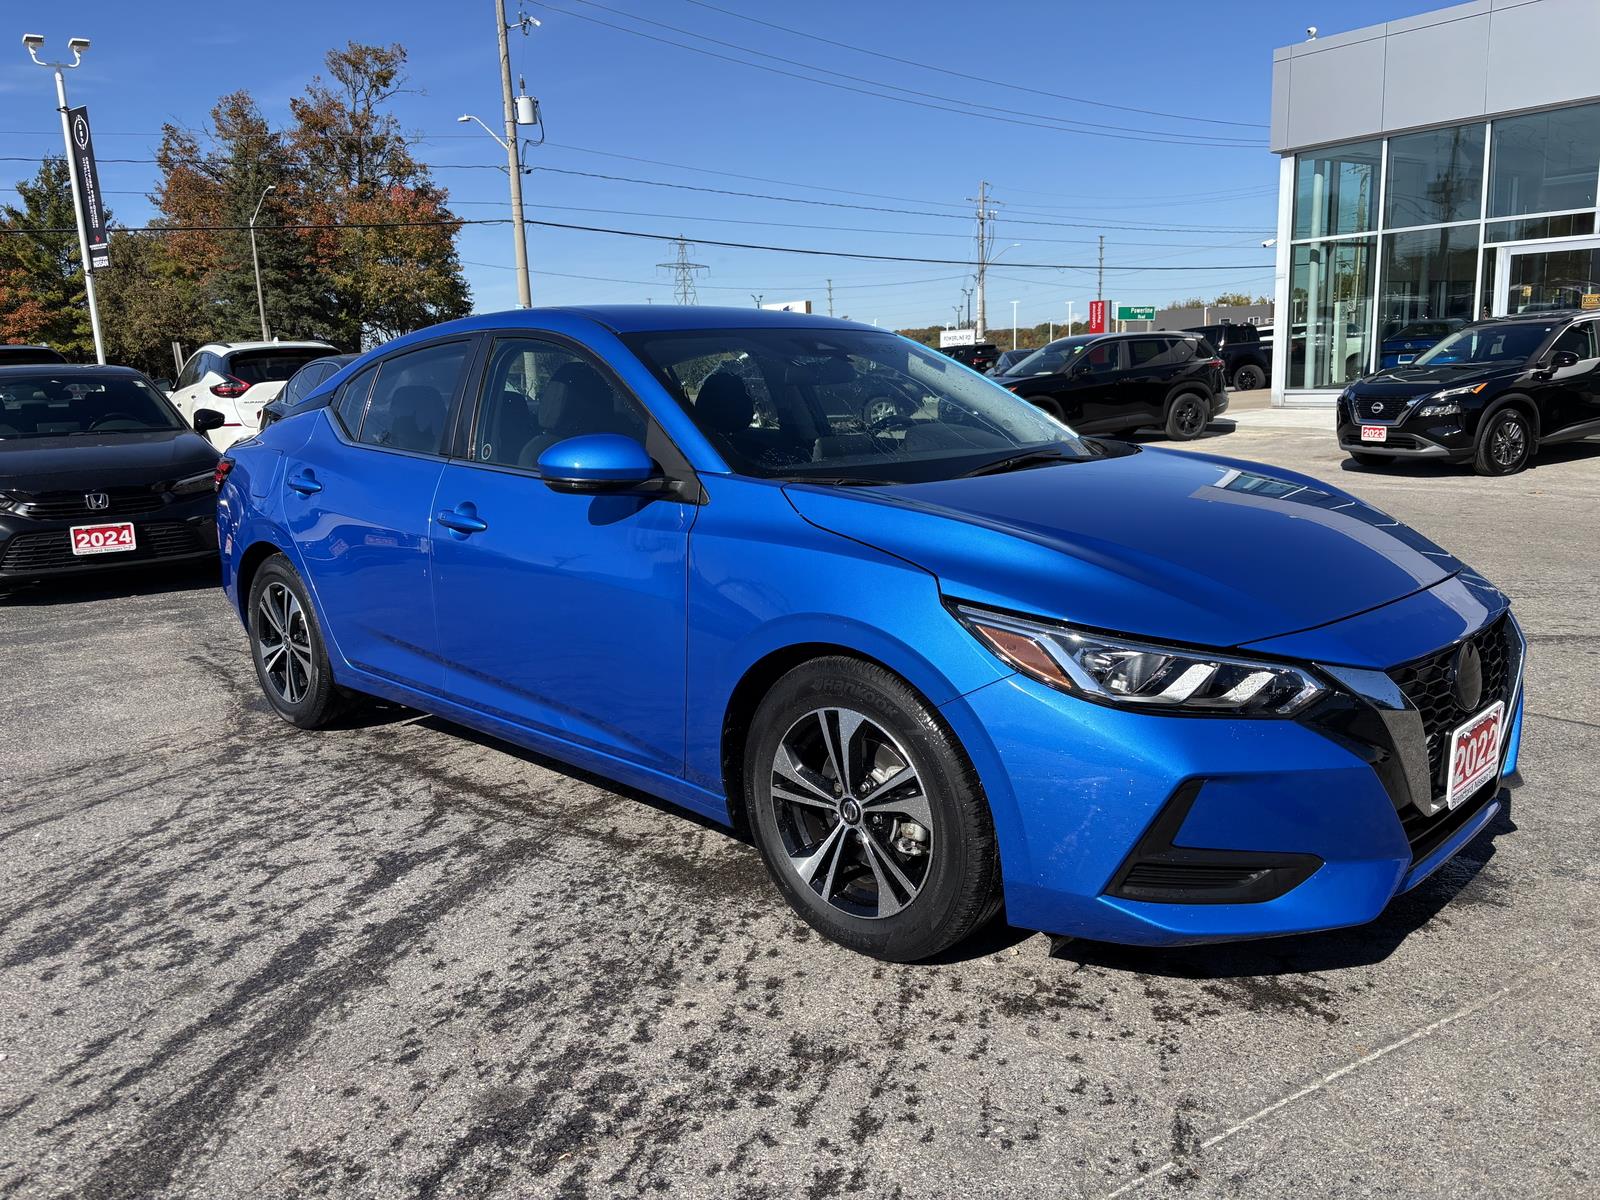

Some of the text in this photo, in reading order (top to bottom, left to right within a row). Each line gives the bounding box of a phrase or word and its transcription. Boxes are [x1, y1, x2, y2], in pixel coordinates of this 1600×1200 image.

[90, 190, 99, 228] PRE-OWNED
[1364, 429, 1385, 438] 2023
[76, 530, 132, 548] 2024
[1453, 723, 1498, 786] 2022
